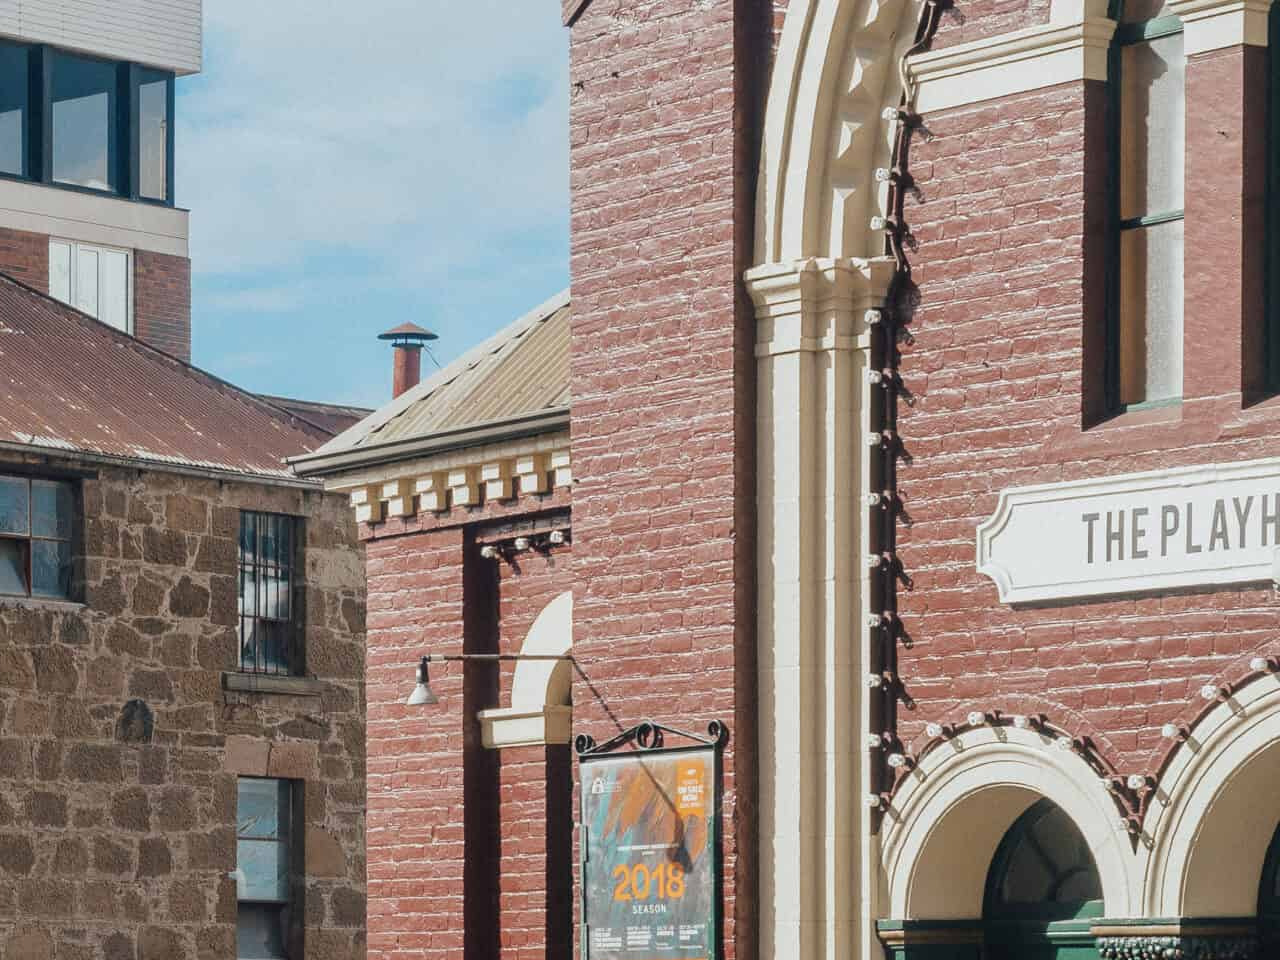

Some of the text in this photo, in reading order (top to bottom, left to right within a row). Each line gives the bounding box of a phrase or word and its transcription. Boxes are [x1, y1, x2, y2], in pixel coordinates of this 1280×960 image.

[1082, 492, 1280, 563] THE PLAYH
[613, 863, 686, 901] 2018
[632, 903, 666, 914] SEASON
